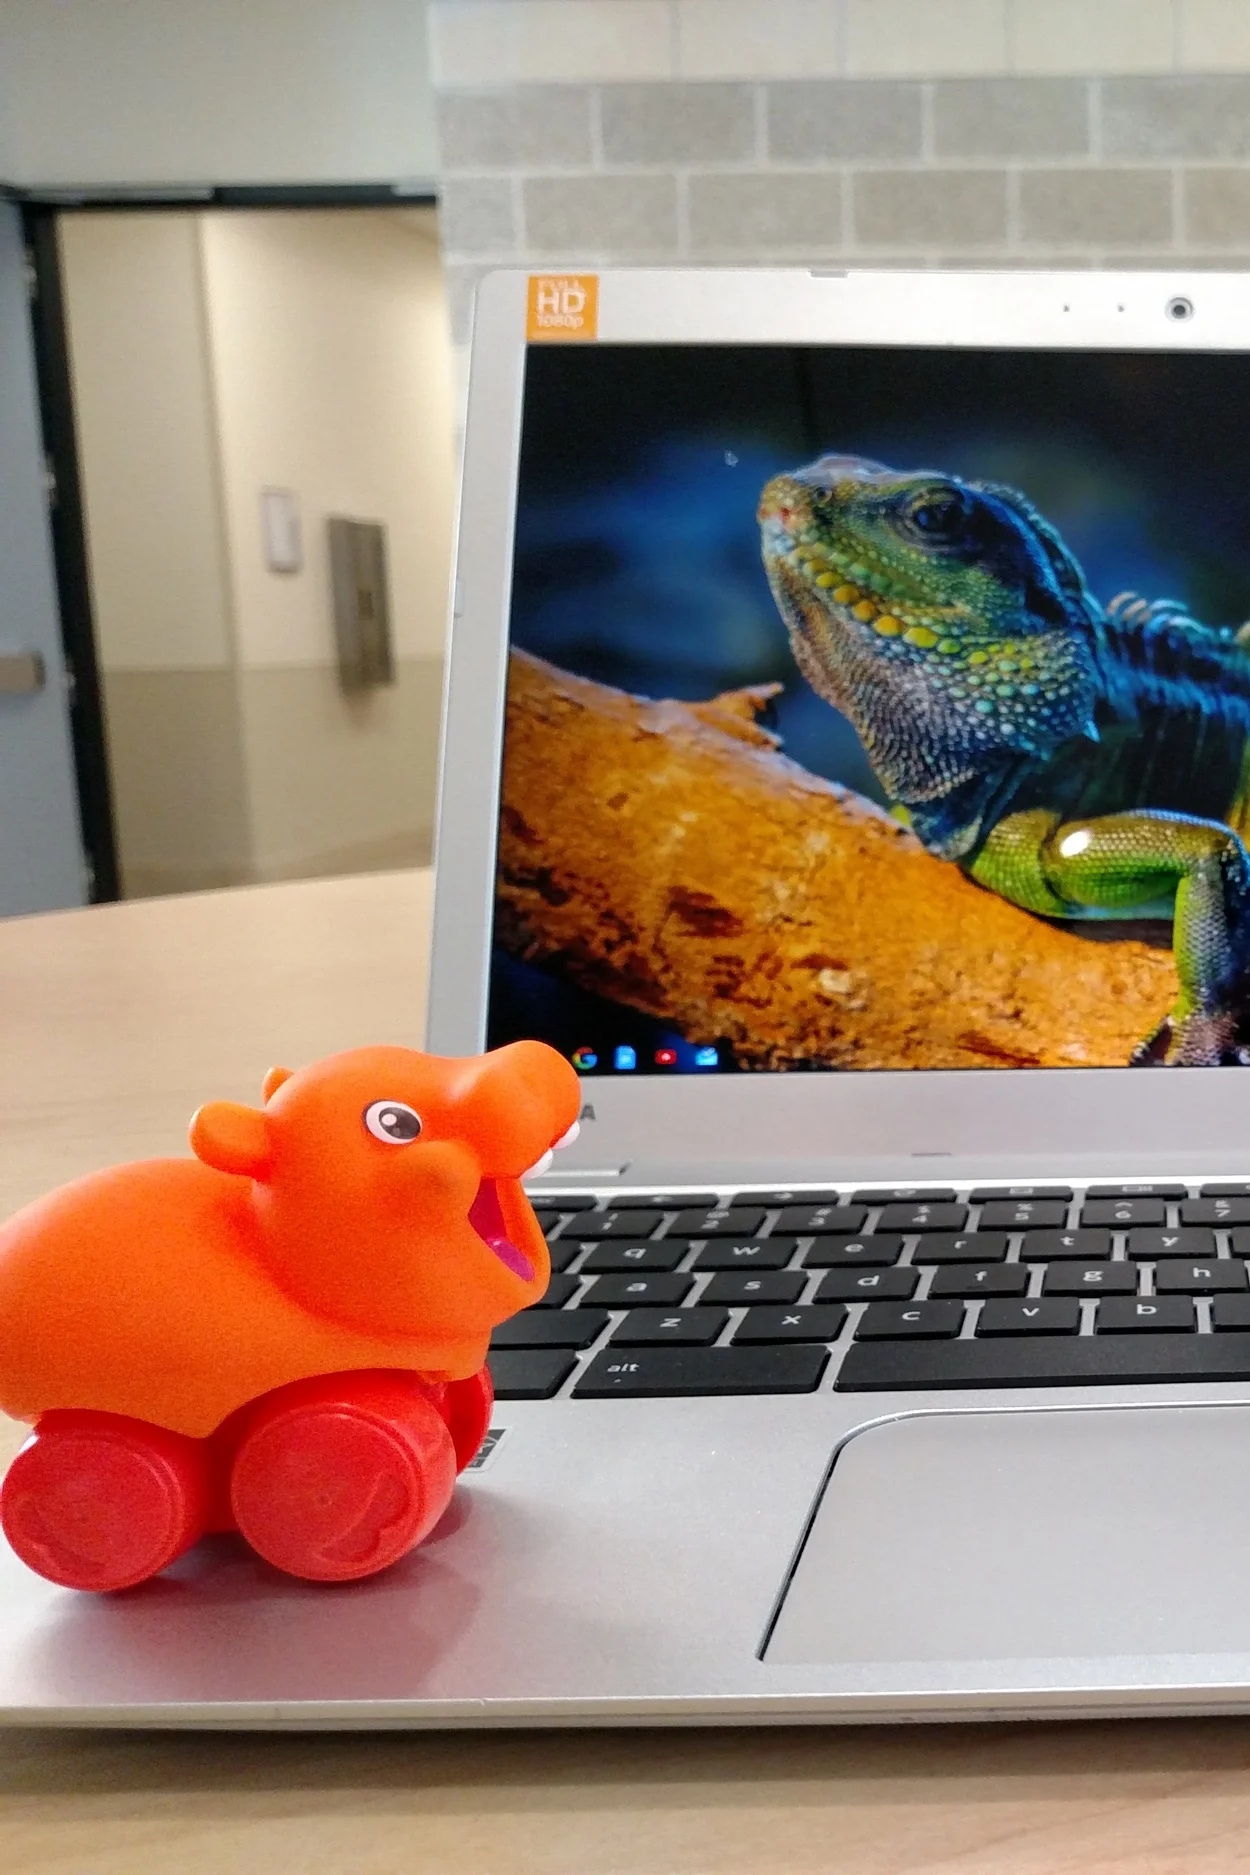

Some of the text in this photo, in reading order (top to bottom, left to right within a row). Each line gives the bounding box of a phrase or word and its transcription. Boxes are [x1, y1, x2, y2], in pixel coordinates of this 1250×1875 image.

[537, 290, 585, 314] HD
[1015, 1212, 1029, 1221] 5
[1115, 1210, 1132, 1220] 6
[1215, 1208, 1231, 1218] 7
[912, 1214, 927, 1224] 4
[954, 1240, 967, 1249] r
[1060, 1236, 1075, 1246] t
[1161, 1236, 1179, 1247] y
[624, 1247, 646, 1259] q
[732, 1246, 761, 1256] w
[844, 1243, 864, 1253] e
[975, 1270, 988, 1282] f
[1083, 1270, 1103, 1282] g
[1193, 1266, 1211, 1278] h
[743, 1280, 762, 1291] s
[857, 1274, 880, 1286] d
[626, 1282, 648, 1292] a
[1022, 1307, 1040, 1317] v
[1136, 1303, 1157, 1315] b
[781, 1314, 801, 1325] x
[901, 1310, 921, 1321] c
[659, 1317, 681, 1328] z
[606, 1362, 640, 1373] alt
